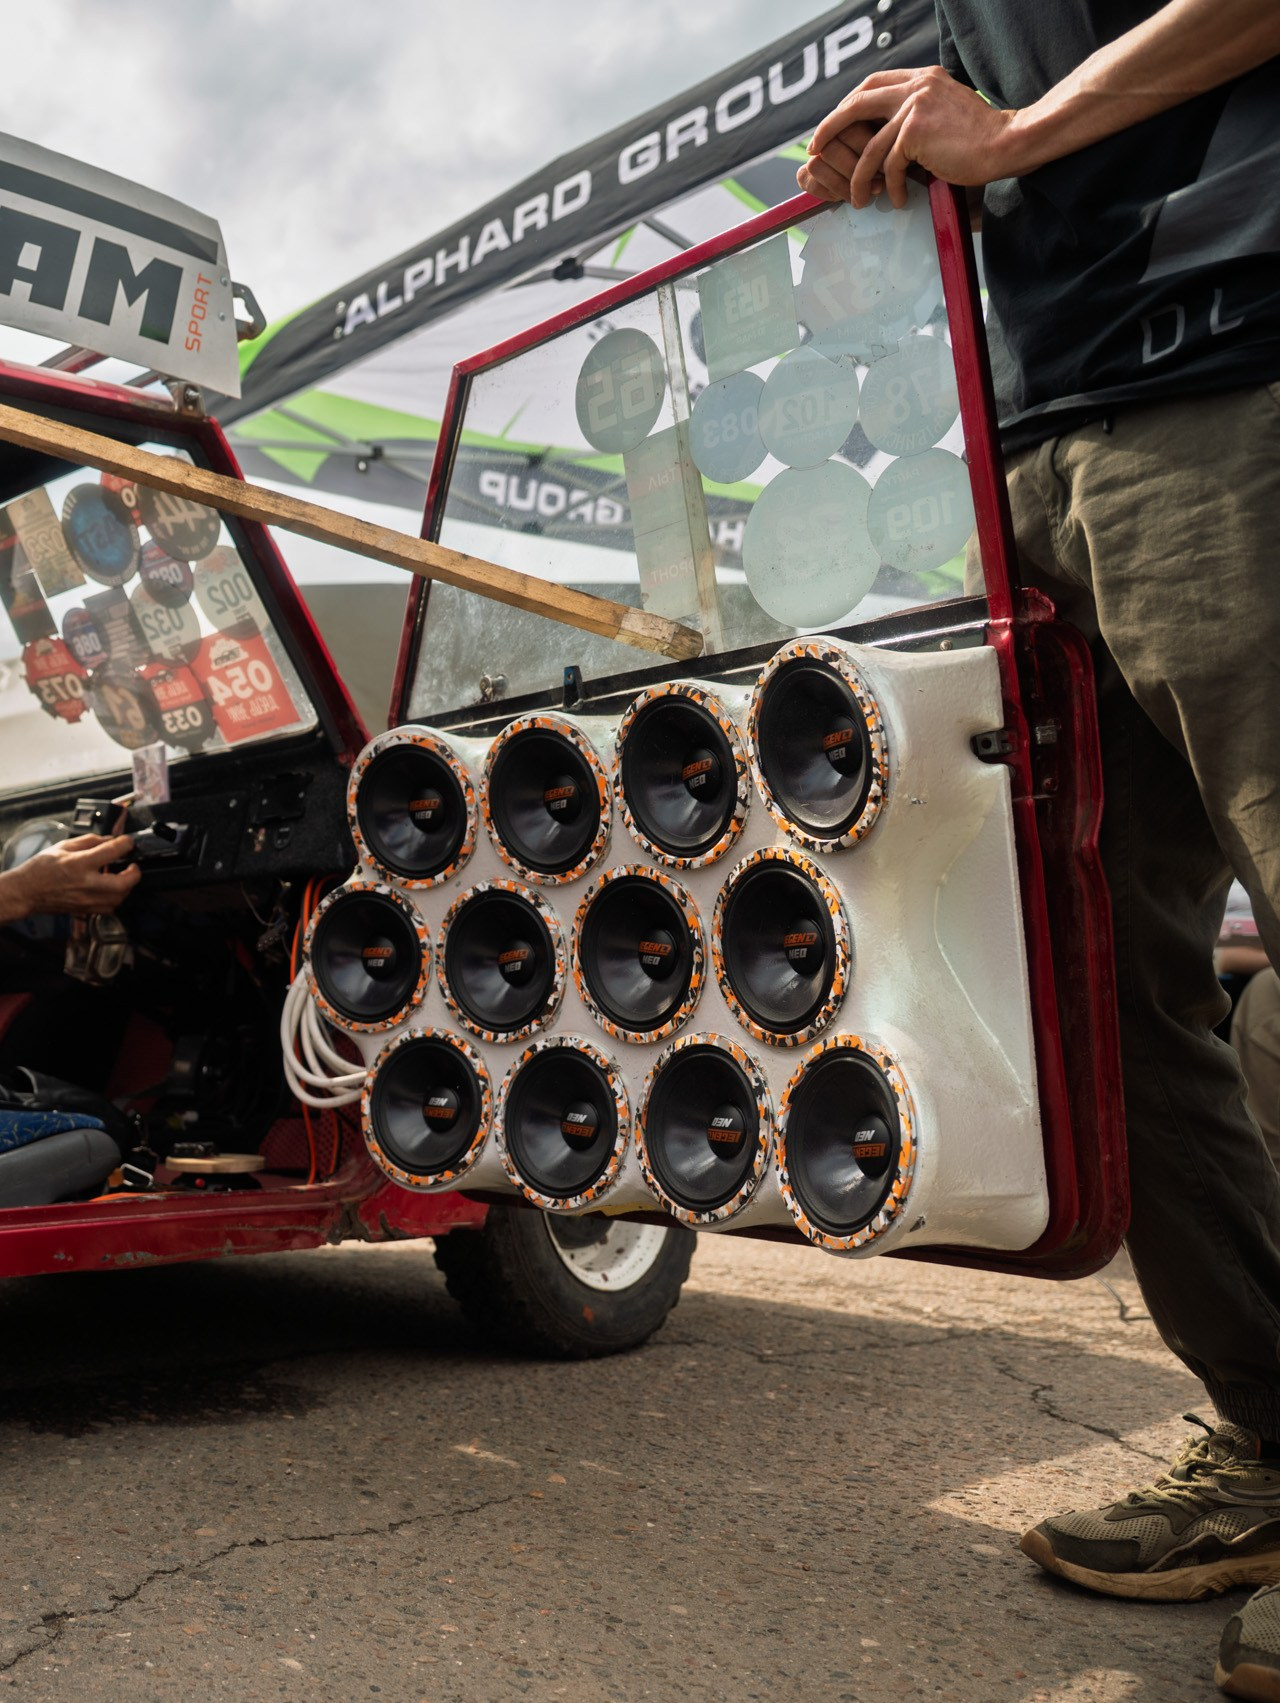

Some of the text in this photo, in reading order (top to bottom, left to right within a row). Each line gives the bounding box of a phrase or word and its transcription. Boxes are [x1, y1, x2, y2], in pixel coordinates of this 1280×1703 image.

[342, 14, 875, 336] ALPHARD GROUP
[185, 272, 213, 353] SPORT
[828, 747, 846, 762] NEO
[689, 773, 706, 790] NEO
[550, 799, 567, 812] NEO
[415, 810, 432, 820] NEO
[788, 947, 807, 960] NEO
[367, 958, 385, 967] NEO
[642, 955, 661, 965] NEO
[505, 961, 522, 973] NEO
[428, 1096, 449, 1107] NEO
[567, 1111, 588, 1123] NEO
[711, 1116, 733, 1128] NEO
[854, 1129, 876, 1143] NEO
